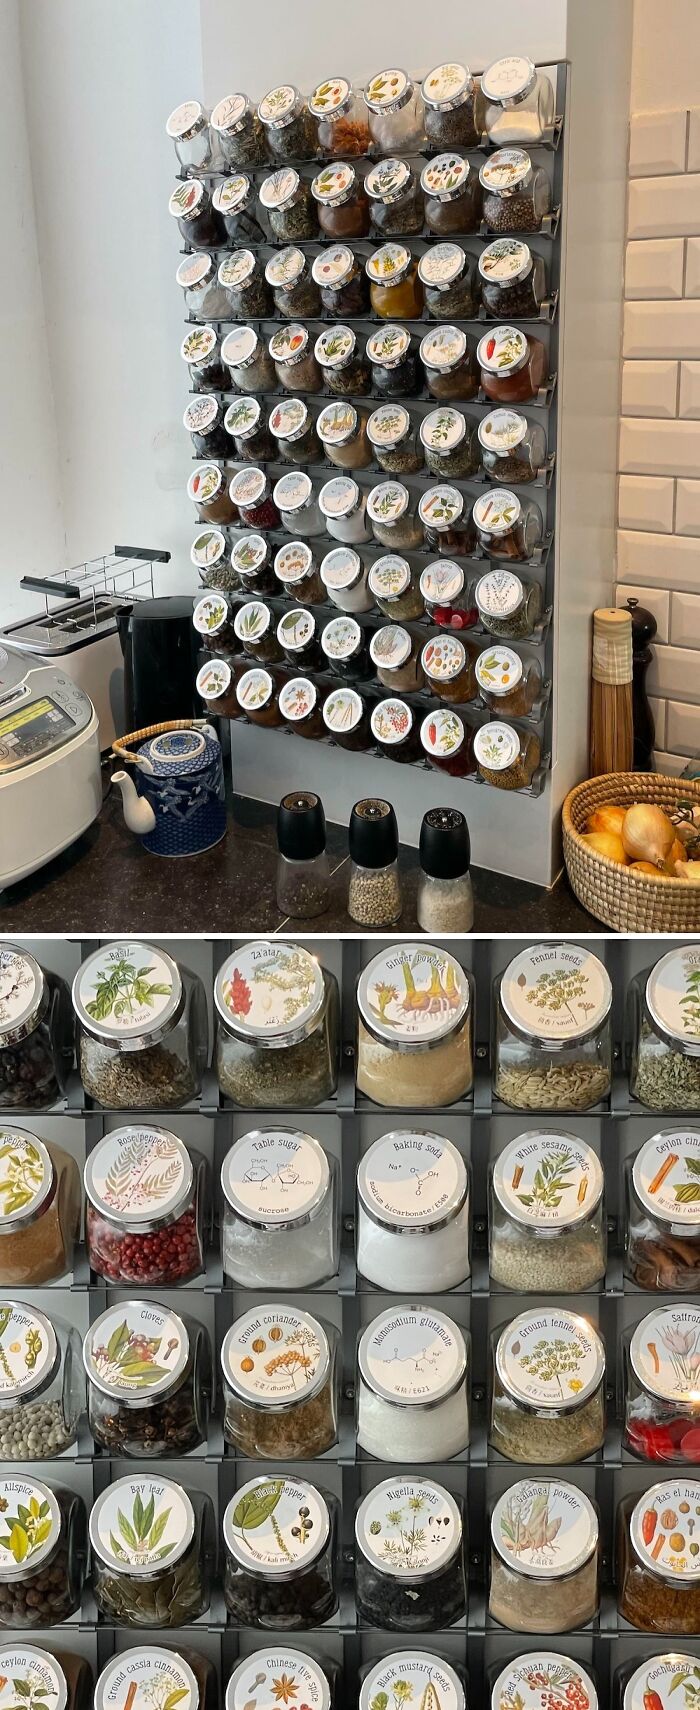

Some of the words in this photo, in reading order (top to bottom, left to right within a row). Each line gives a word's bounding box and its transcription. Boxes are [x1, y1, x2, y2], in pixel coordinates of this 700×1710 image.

[109, 948, 131, 961] Basil
[386, 952, 412, 970] Ginger
[416, 953, 446, 972] powder
[530, 951, 557, 966] Fennel
[561, 951, 582, 967] seeds
[3, 1135, 29, 1150] pepper
[117, 1134, 137, 1148] Rose
[138, 1133, 166, 1147] pepper
[252, 1138, 275, 1152] Table
[277, 1138, 302, 1153] sugar
[394, 1138, 423, 1152] Baking
[425, 1144, 443, 1160] soda
[656, 1136, 682, 1154] Ceylon
[515, 1141, 539, 1160] White
[541, 1141, 573, 1154] sesame
[572, 1150, 590, 1172] seeds
[427, 1170, 439, 1178] OH
[369, 1180, 384, 1204] sodium
[258, 1206, 290, 1215] sucrose
[8, 1312, 35, 1328] pepper
[140, 1309, 165, 1326] Cloves
[238, 1320, 262, 1344] Ground
[263, 1314, 302, 1329] coriander
[372, 1315, 417, 1347] Monosodium
[419, 1317, 452, 1348] glutamate
[519, 1317, 547, 1339] Ground
[575, 1327, 592, 1354] seeds
[412, 1385, 430, 1394] E621
[3, 1481, 34, 1497] Allspice
[130, 1484, 146, 1495] Bay
[148, 1484, 165, 1496] leaf
[253, 1485, 278, 1500] Black
[279, 1485, 306, 1502] pepper
[387, 1486, 414, 1501] Nigella
[417, 1488, 439, 1506] seeds
[656, 1492, 671, 1504] Ras
[673, 1488, 682, 1498] el
[552, 1489, 580, 1510] powder
[28, 1659, 57, 1694] cinnamon
[108, 1670, 127, 1701] Ground
[127, 1658, 151, 1675] cassia
[154, 1659, 186, 1689] cinnamon
[266, 1658, 297, 1671] Chinese
[308, 1682, 319, 1703] spice
[378, 1667, 396, 1689] Black
[398, 1662, 433, 1676] mustard
[432, 1674, 451, 1692] seeds
[506, 1682, 518, 1697] Red
[515, 1661, 545, 1682] Sichuan
[547, 1662, 573, 1679] pepper
